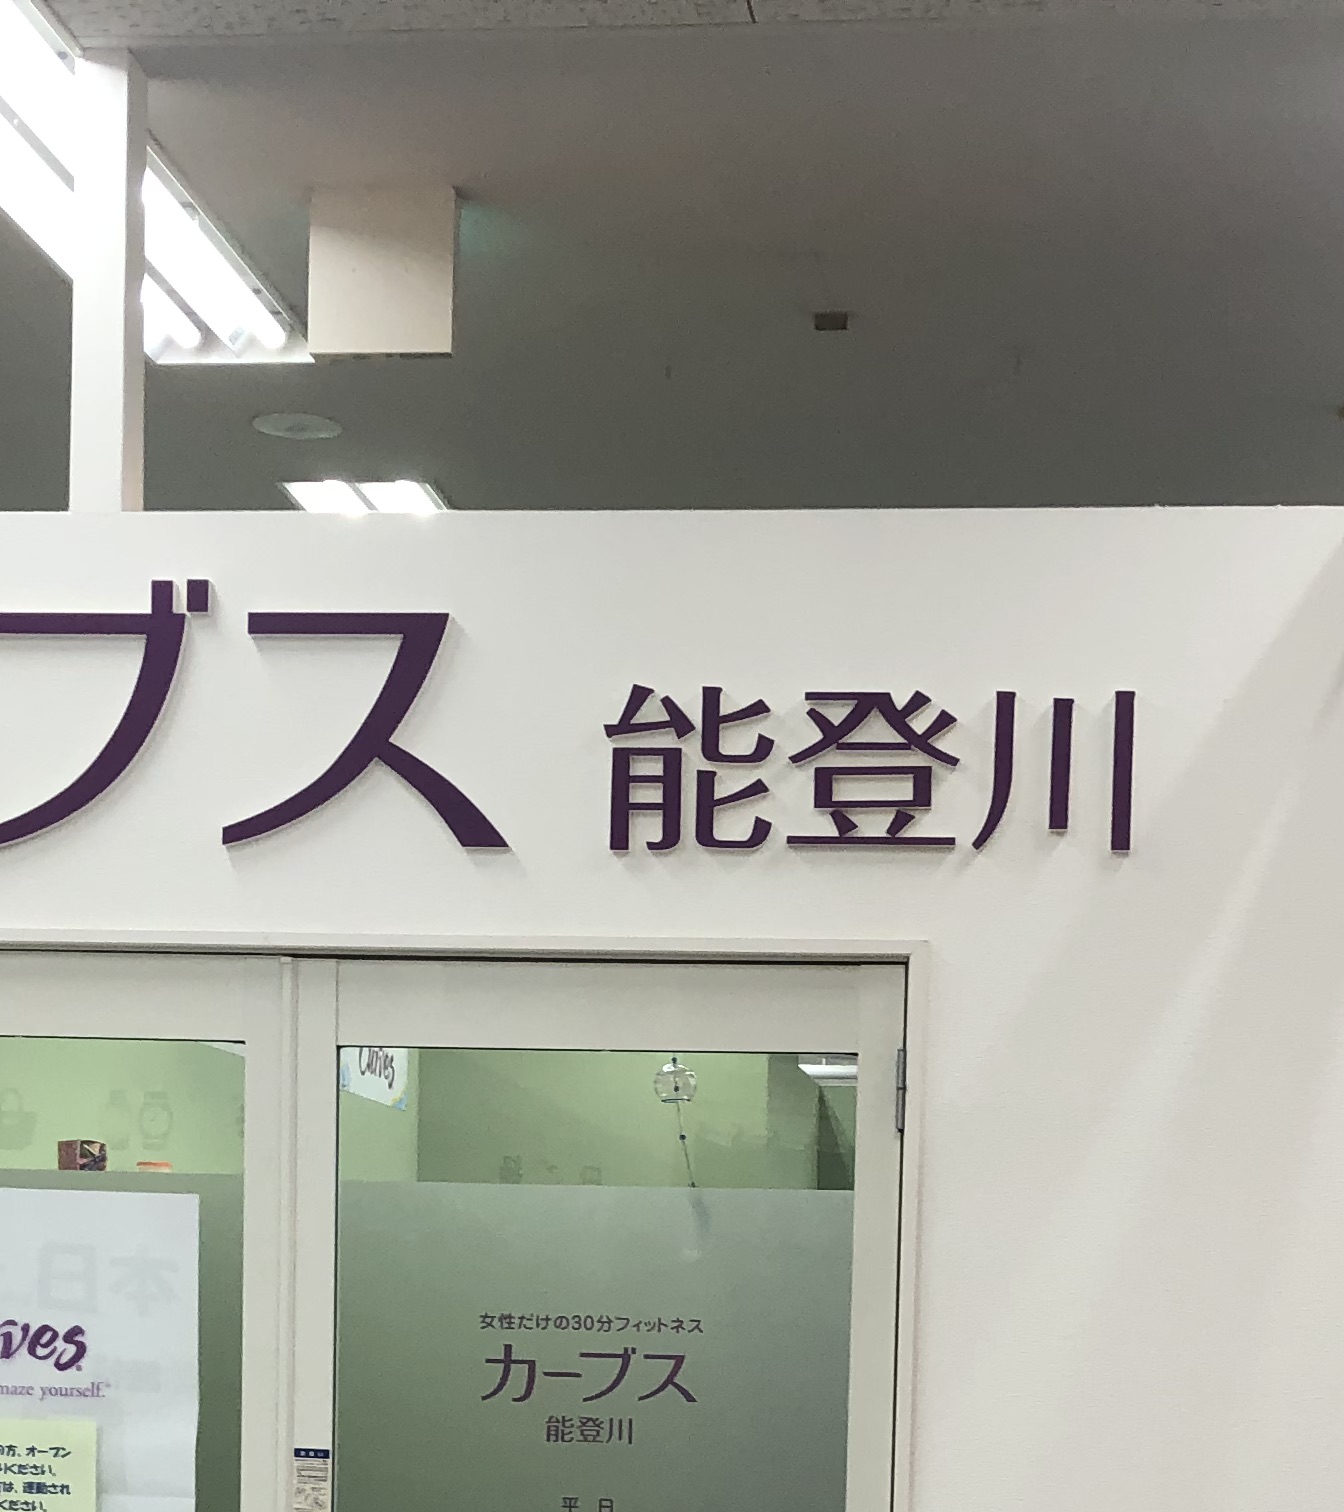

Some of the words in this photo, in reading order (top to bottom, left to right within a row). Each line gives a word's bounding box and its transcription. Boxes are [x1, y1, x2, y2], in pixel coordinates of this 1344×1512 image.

[603, 682, 1136, 853] 能登川
[478, 1312, 705, 1335] 女性だけの30分フィットネス
[481, 1343, 698, 1404] カーブス
[544, 1415, 635, 1445] 能登川
